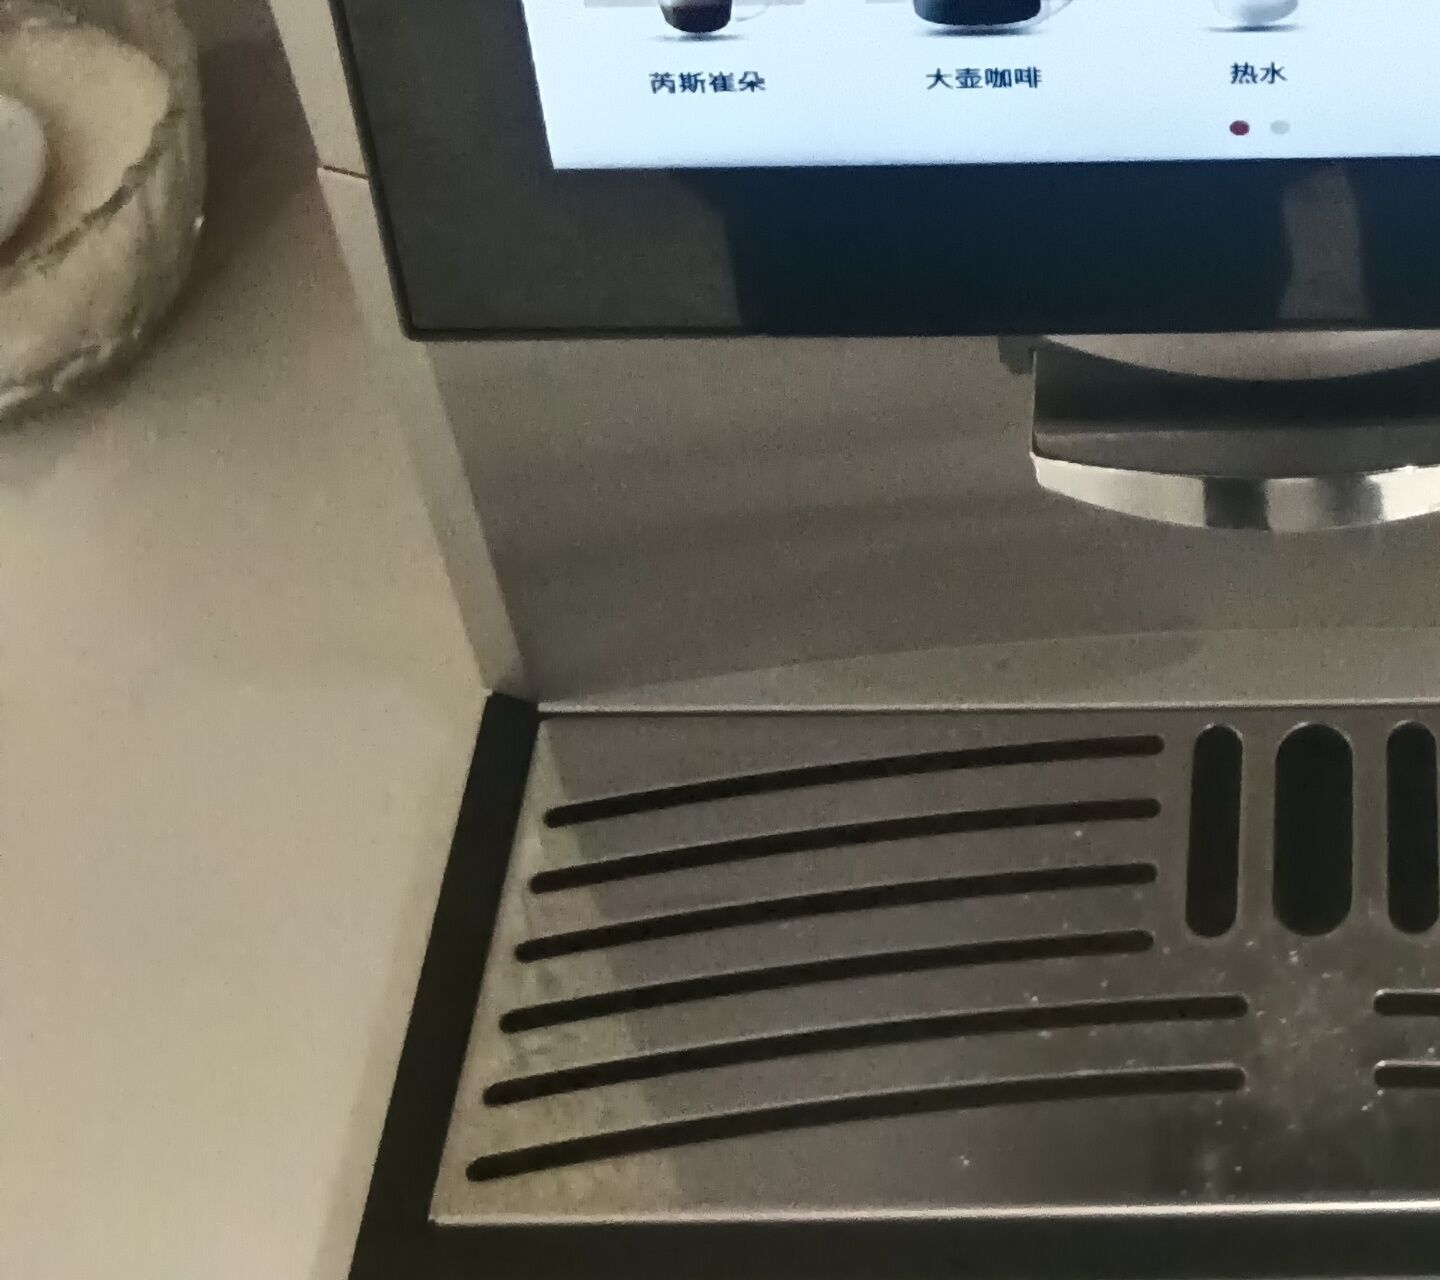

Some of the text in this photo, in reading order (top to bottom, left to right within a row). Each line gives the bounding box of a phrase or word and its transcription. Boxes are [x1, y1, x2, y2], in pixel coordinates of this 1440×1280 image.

[649, 70, 766, 95] 芮斯崔朵
[926, 66, 1042, 90] 大壶咖啡
[1230, 61, 1287, 85] 热水
